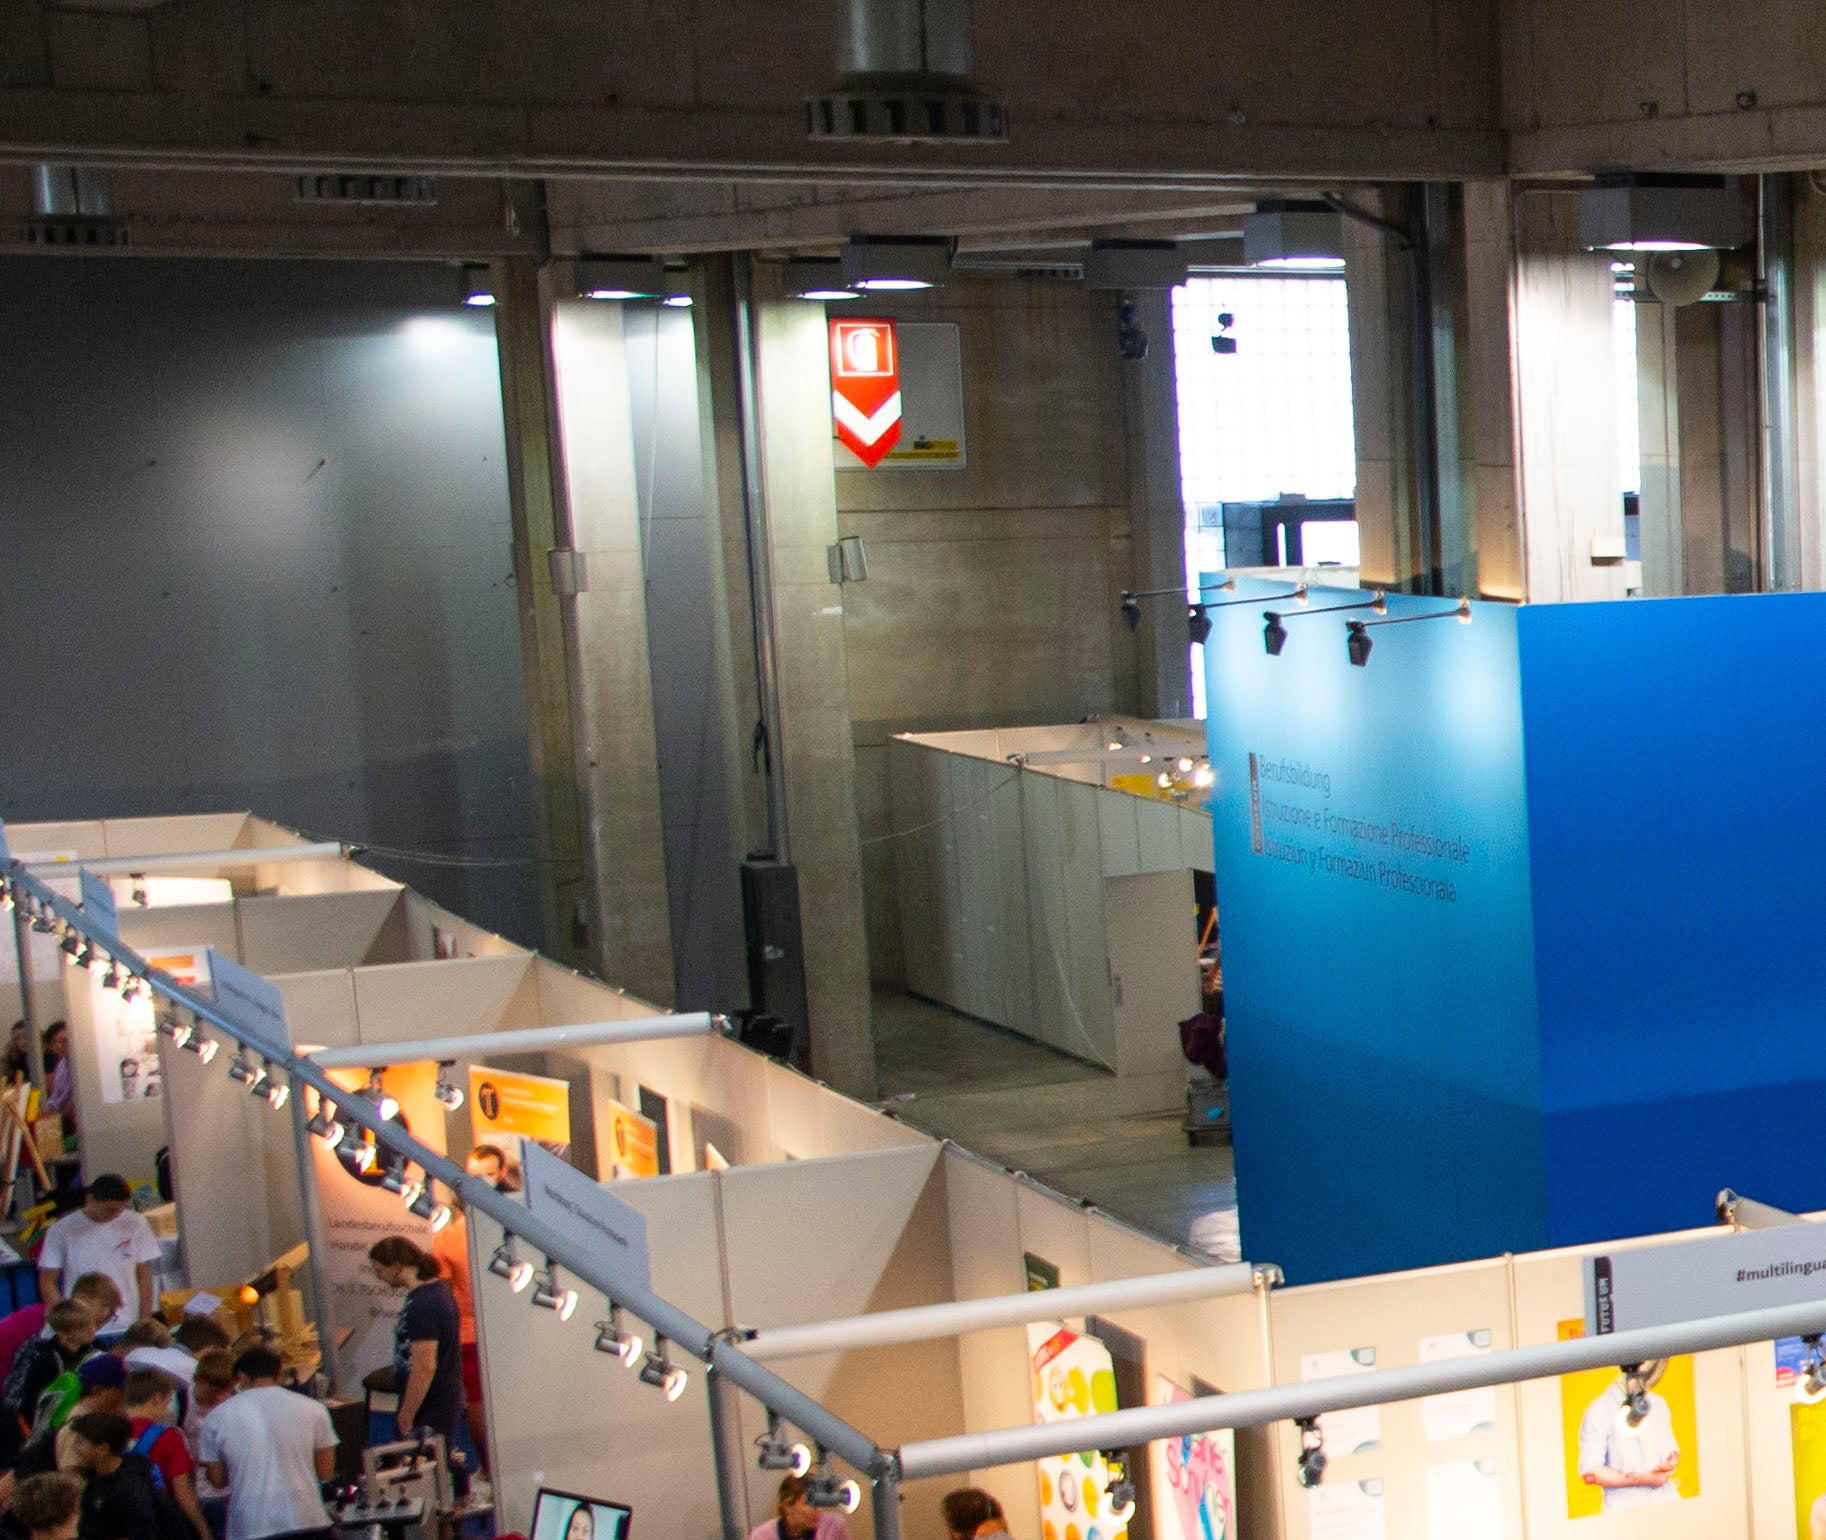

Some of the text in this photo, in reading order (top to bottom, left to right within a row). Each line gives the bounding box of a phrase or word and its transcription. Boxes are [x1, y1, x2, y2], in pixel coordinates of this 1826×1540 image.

[1260, 754, 1332, 799] Berufsbildung
[1262, 795, 1471, 864] Istruzione e Formazione Professionale
[1319, 846, 1377, 883] Formaziun
